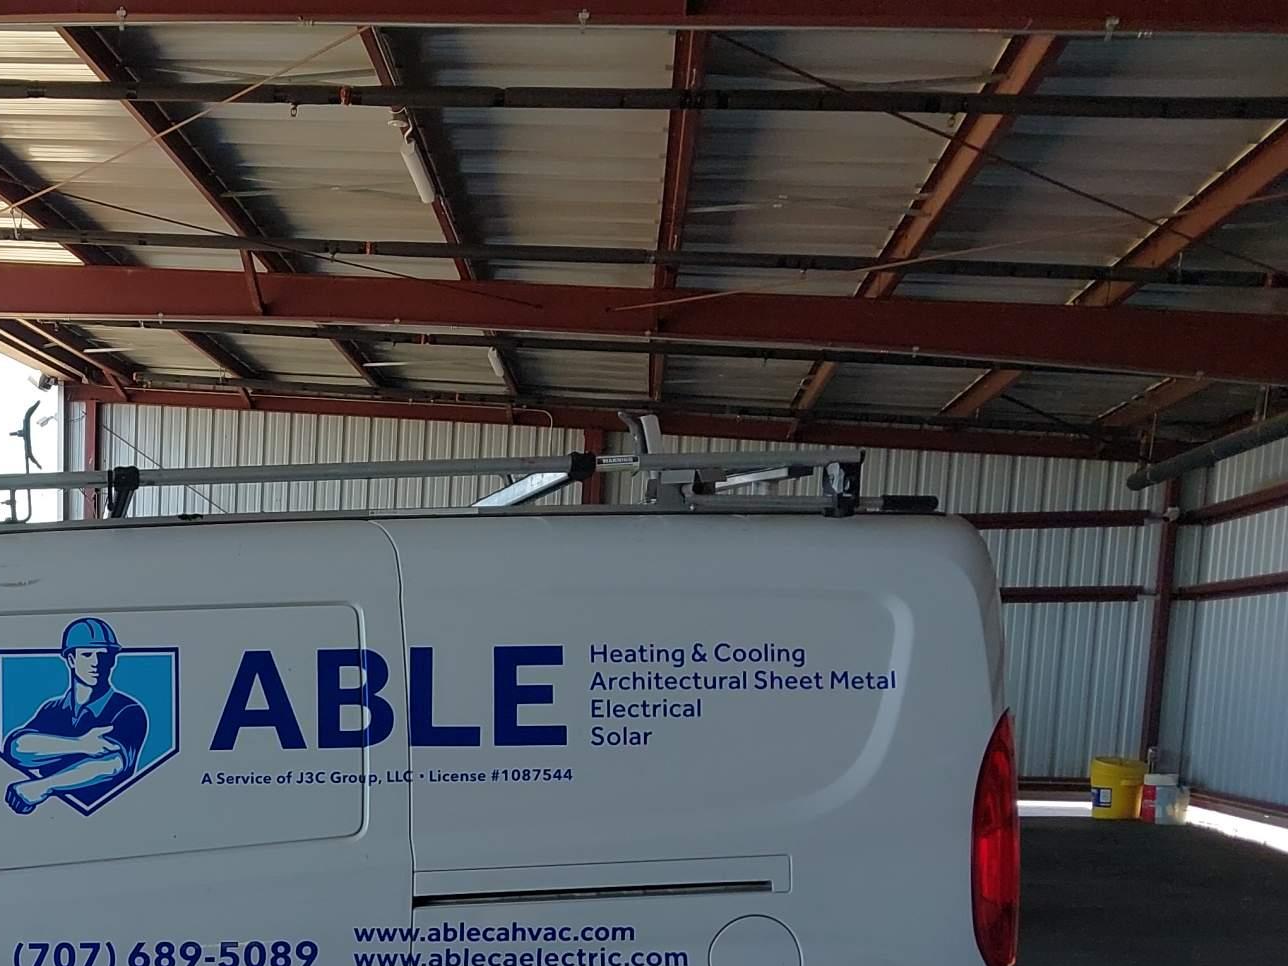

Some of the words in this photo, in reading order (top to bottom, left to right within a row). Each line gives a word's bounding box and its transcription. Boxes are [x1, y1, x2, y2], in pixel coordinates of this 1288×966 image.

[590, 644, 685, 667] Heating
[691, 643, 708, 663] &
[714, 643, 806, 667] Cooling
[590, 671, 747, 690] Architectural
[754, 670, 824, 690] Sheet
[830, 670, 897, 690] Metal
[209, 645, 568, 751] ABLE
[590, 699, 702, 718] Electrical
[590, 726, 653, 746] Solar
[201, 773, 213, 785] A
[216, 771, 272, 785] Service
[276, 771, 293, 785] of
[296, 771, 326, 784] J3C
[330, 771, 383, 786] Group,
[386, 769, 414, 783] LLC
[429, 769, 487, 783] License
[491, 768, 573, 782] #1087544
[353, 922, 636, 943] www.ablecahvac.com
